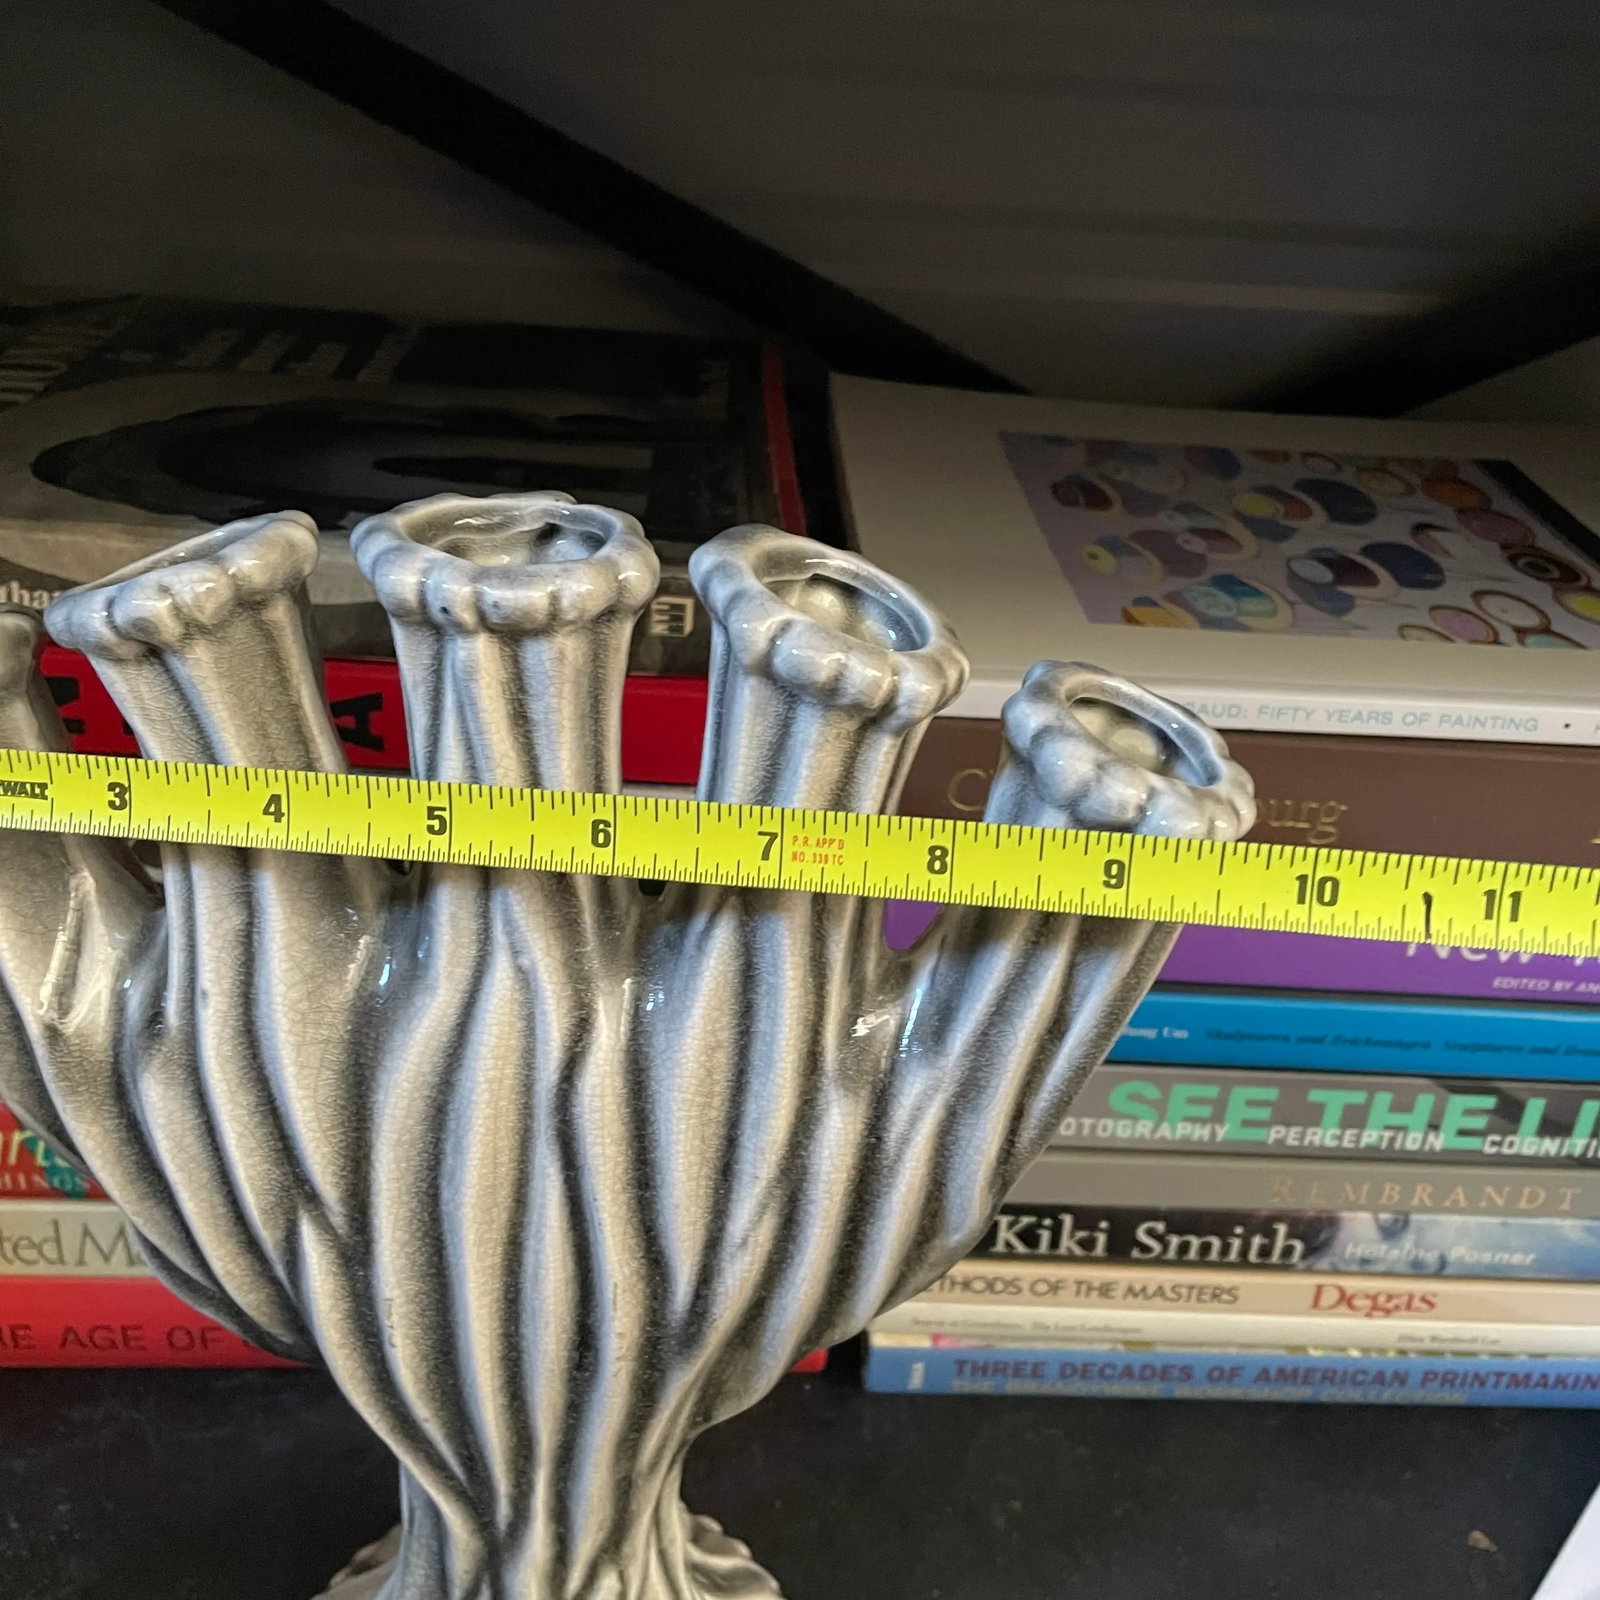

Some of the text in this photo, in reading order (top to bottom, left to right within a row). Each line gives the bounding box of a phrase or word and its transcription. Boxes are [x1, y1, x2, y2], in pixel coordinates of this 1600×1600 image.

[1257, 705, 1316, 721] FIFTY
[1325, 708, 1393, 725] YEARS
[1402, 711, 1431, 727] OF
[1438, 713, 1539, 732] PAINTING
[107, 782, 128, 811] 3
[262, 794, 286, 823] 4
[426, 806, 448, 836] 5
[590, 819, 612, 849] 6
[757, 831, 779, 861] 7
[926, 845, 950, 875] 8
[1103, 859, 1127, 889] 9
[1295, 874, 1341, 908] 10
[1482, 888, 1525, 922] 11
[1492, 976, 1550, 991] EDITED
[1552, 980, 1575, 992] BY
[1107, 1079, 1600, 1155] SEE THE LI
[1058, 1116, 1600, 1158] OTOGRAPHY PERCEPTION COGNITI
[1269, 1174, 1583, 1211] REMBRANDT
[989, 1212, 1306, 1266] Kiki Smith
[1029, 1277, 1066, 1297] OF
[1073, 1279, 1120, 1300] THE
[1122, 1283, 1240, 1305] MASTERS
[1309, 1281, 1438, 1318] Degas
[58, 1324, 150, 1351] AGE
[165, 1324, 224, 1351] OF
[953, 1358, 1048, 1380] THREE
[1059, 1361, 1195, 1383] DECADES
[1206, 1364, 1246, 1384] OF
[1253, 1366, 1411, 1388] AMERICAN
